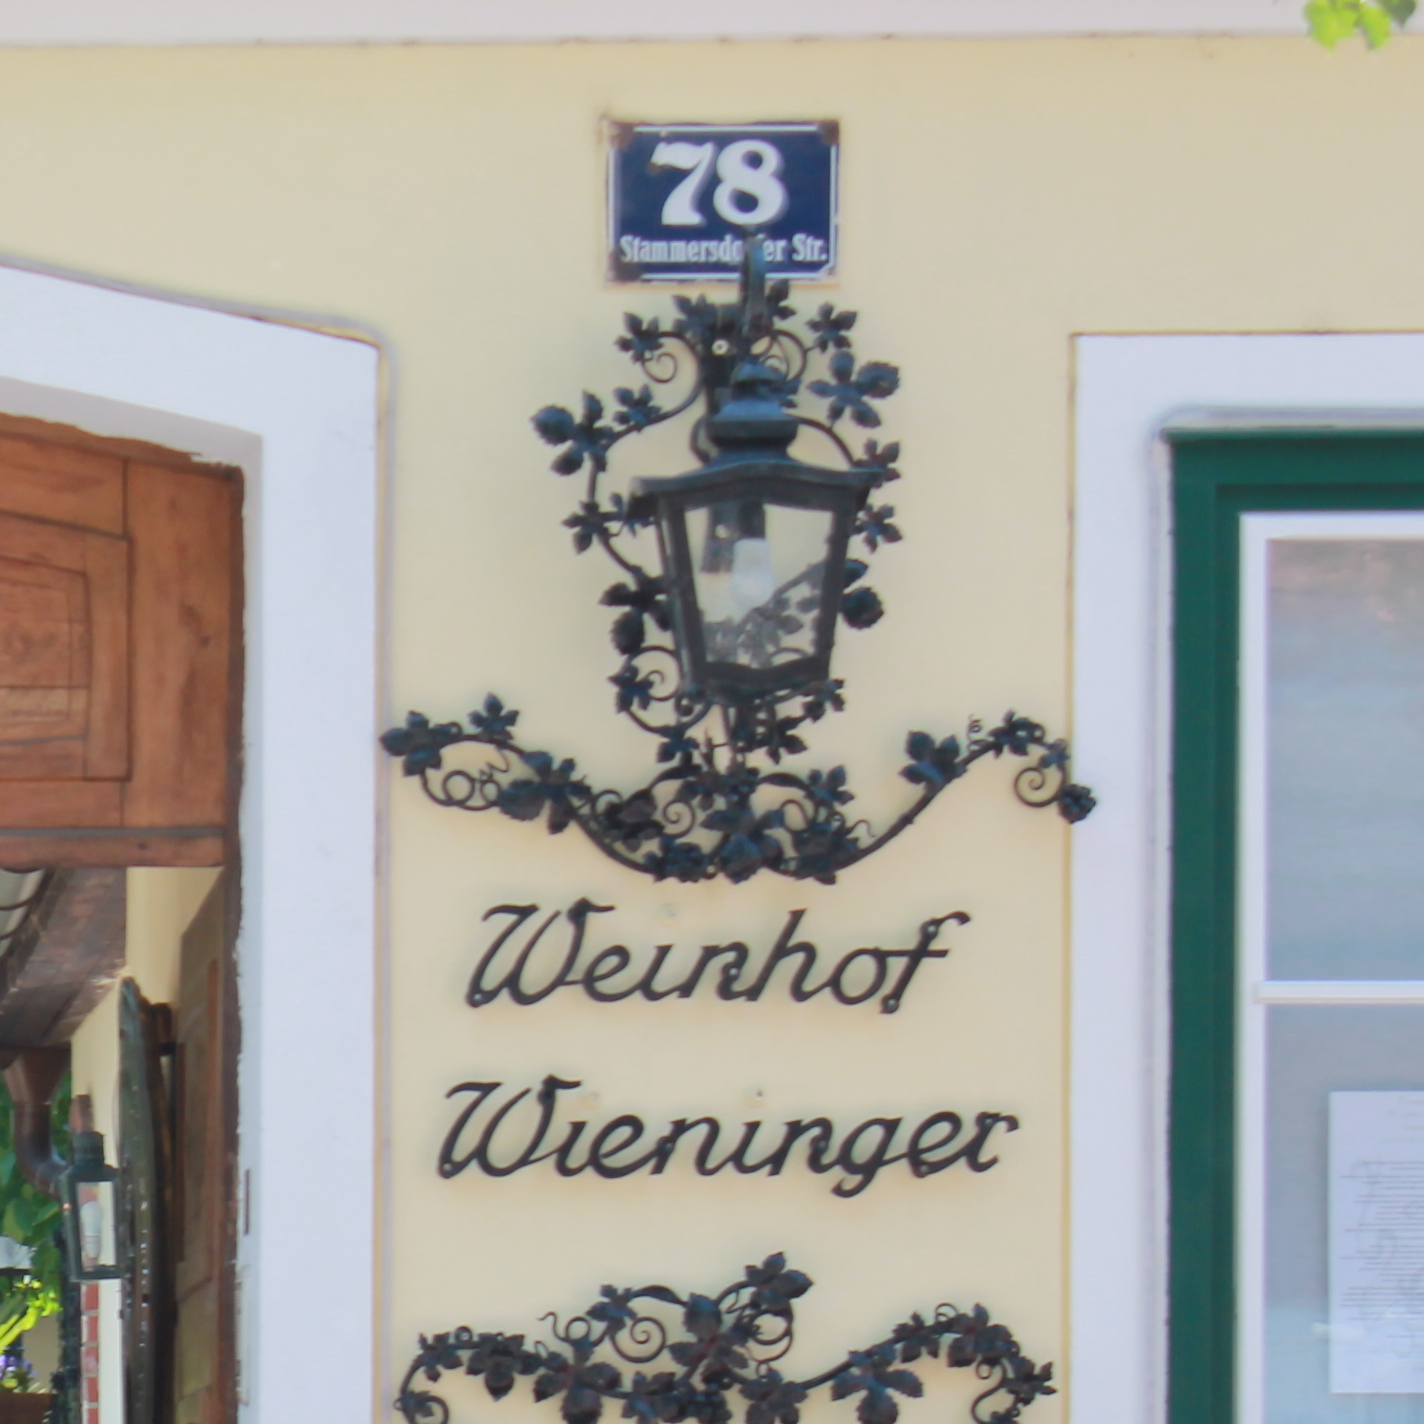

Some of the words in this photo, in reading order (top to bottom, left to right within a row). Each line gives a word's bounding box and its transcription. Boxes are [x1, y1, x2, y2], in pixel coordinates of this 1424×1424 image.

[650, 138, 787, 226] 78
[619, 233, 787, 263] Stammersdoer
[792, 232, 828, 262] Str.
[465, 897, 972, 1014] Weinhof
[438, 1074, 1020, 1198] Wieninger
